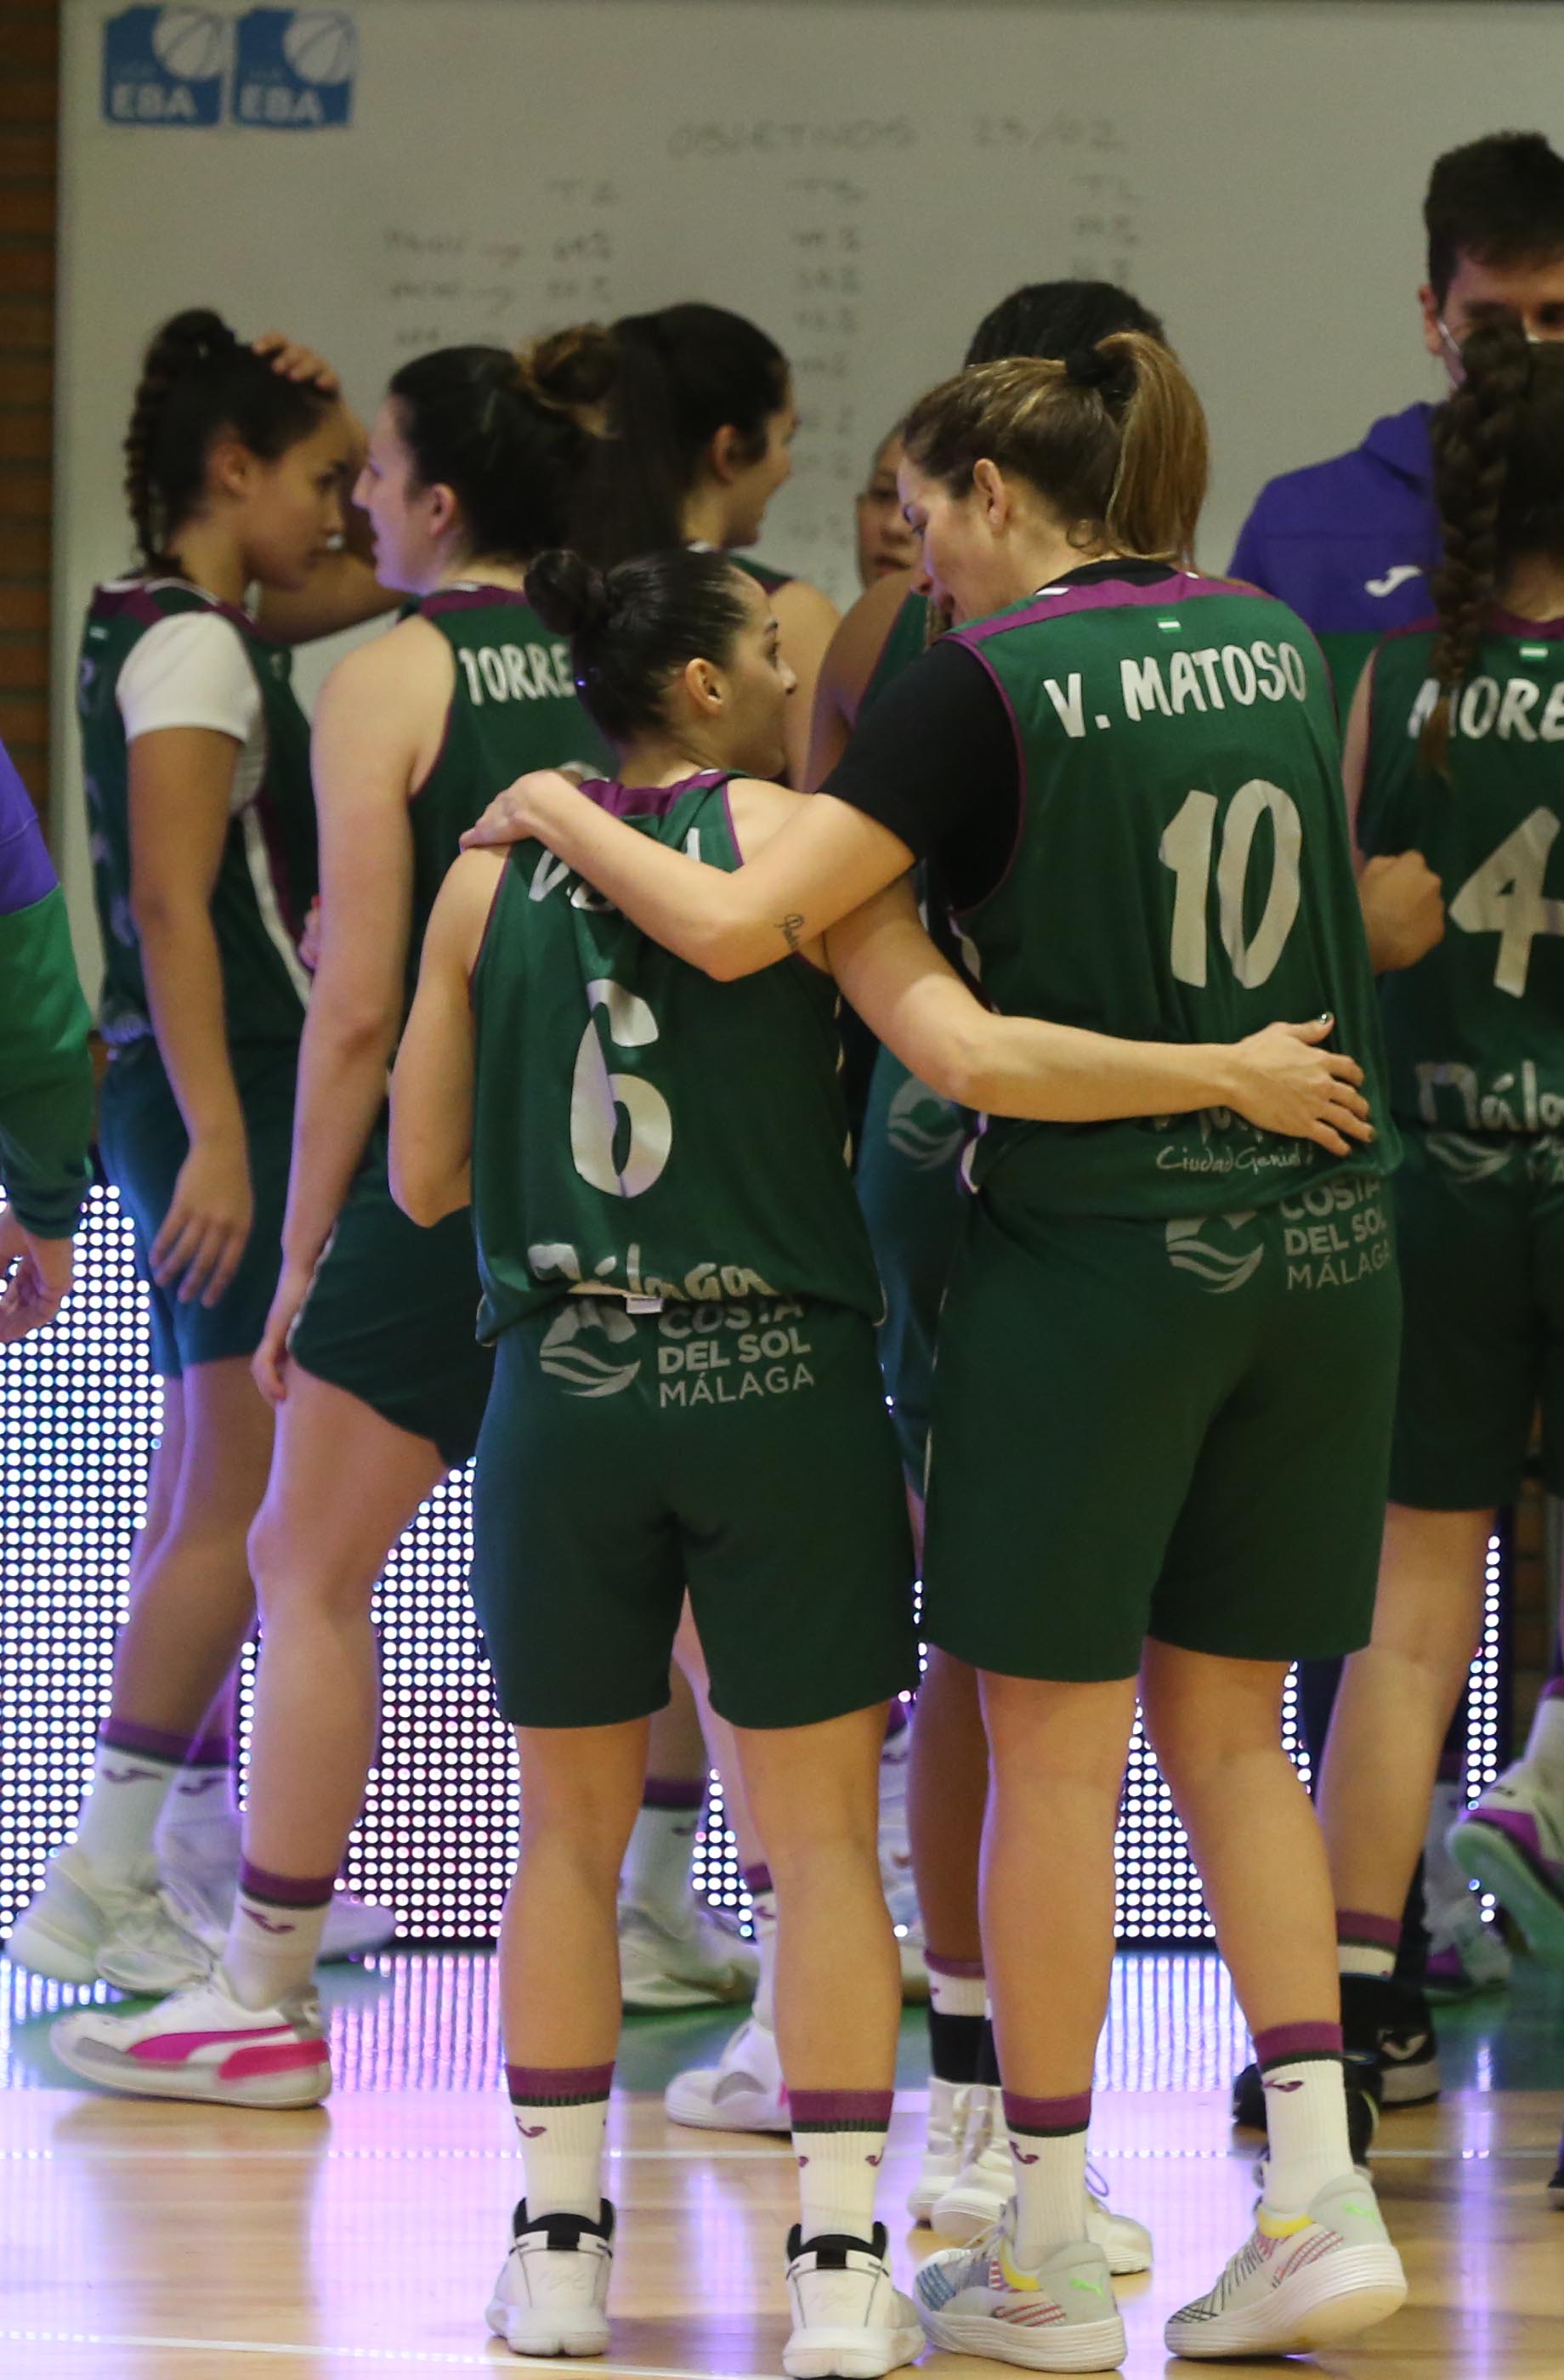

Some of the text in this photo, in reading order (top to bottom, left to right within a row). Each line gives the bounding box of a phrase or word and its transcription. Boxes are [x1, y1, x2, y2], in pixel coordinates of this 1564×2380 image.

[111, 82, 198, 118] EBA
[239, 84, 325, 122] EBA
[1043, 641, 1306, 738] V. MATOSO
[1159, 779, 1302, 989] 10
[1448, 806, 1564, 998] 4
[570, 978, 672, 1198] 6
[1284, 1224, 1350, 1256] DEL
[658, 1327, 812, 1374] DEL SOL
[660, 1363, 815, 1408] MÁLAGA
